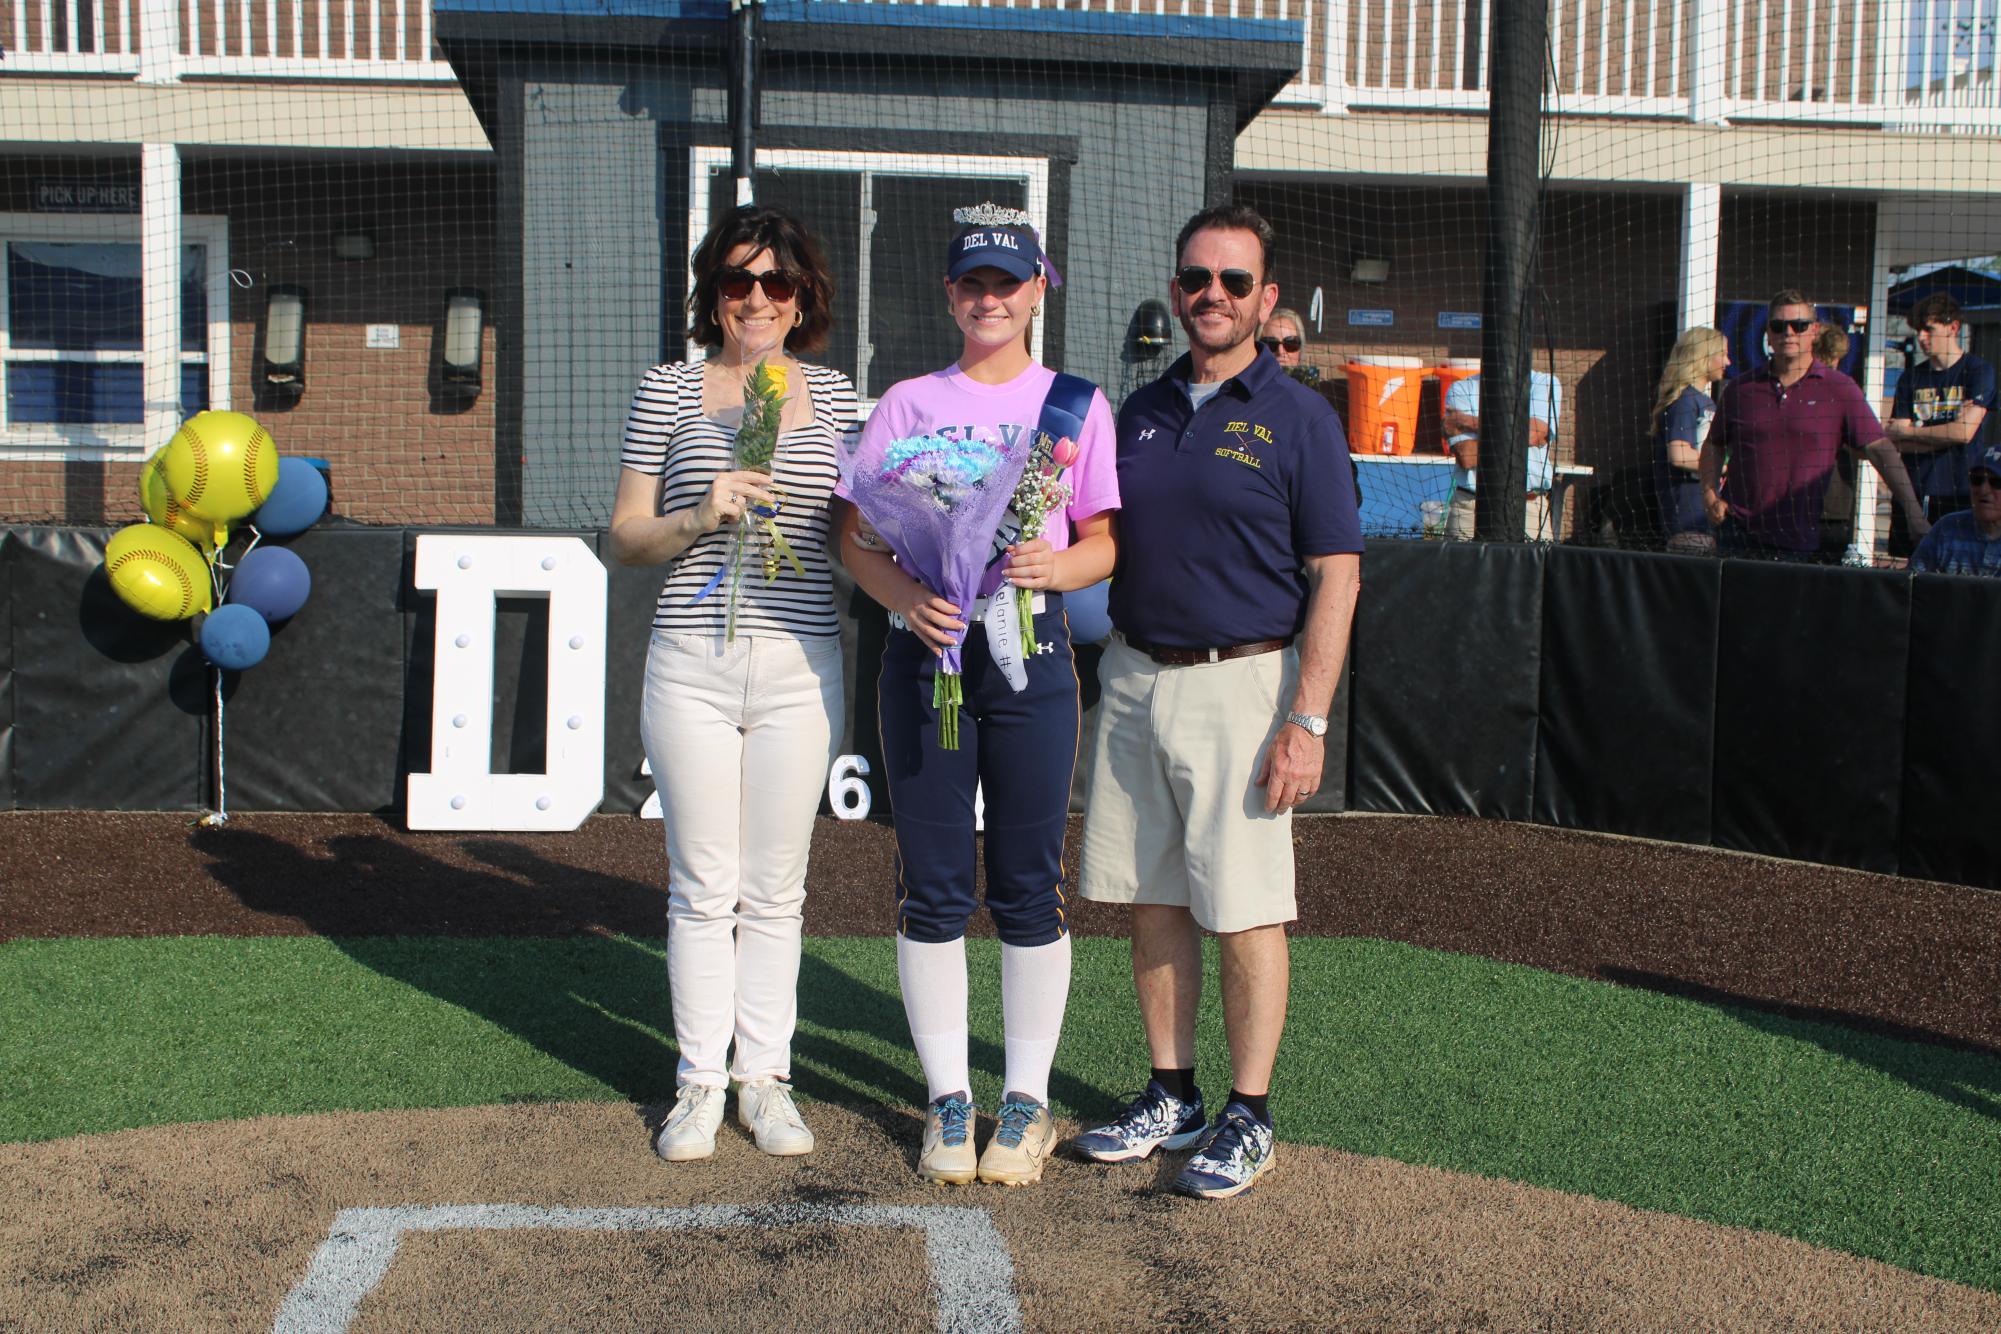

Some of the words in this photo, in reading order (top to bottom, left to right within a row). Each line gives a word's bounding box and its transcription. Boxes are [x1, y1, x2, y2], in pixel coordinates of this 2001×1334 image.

[40, 186, 73, 204] PICK
[77, 186, 97, 204] UP
[100, 187, 136, 205] HERE
[963, 233, 988, 250] DEL
[992, 233, 1018, 250] VAL
[1224, 421, 1249, 432] DEL
[1254, 424, 1273, 444] VAL
[1215, 447, 1261, 468] SOFTBALL
[407, 535, 608, 832] D
